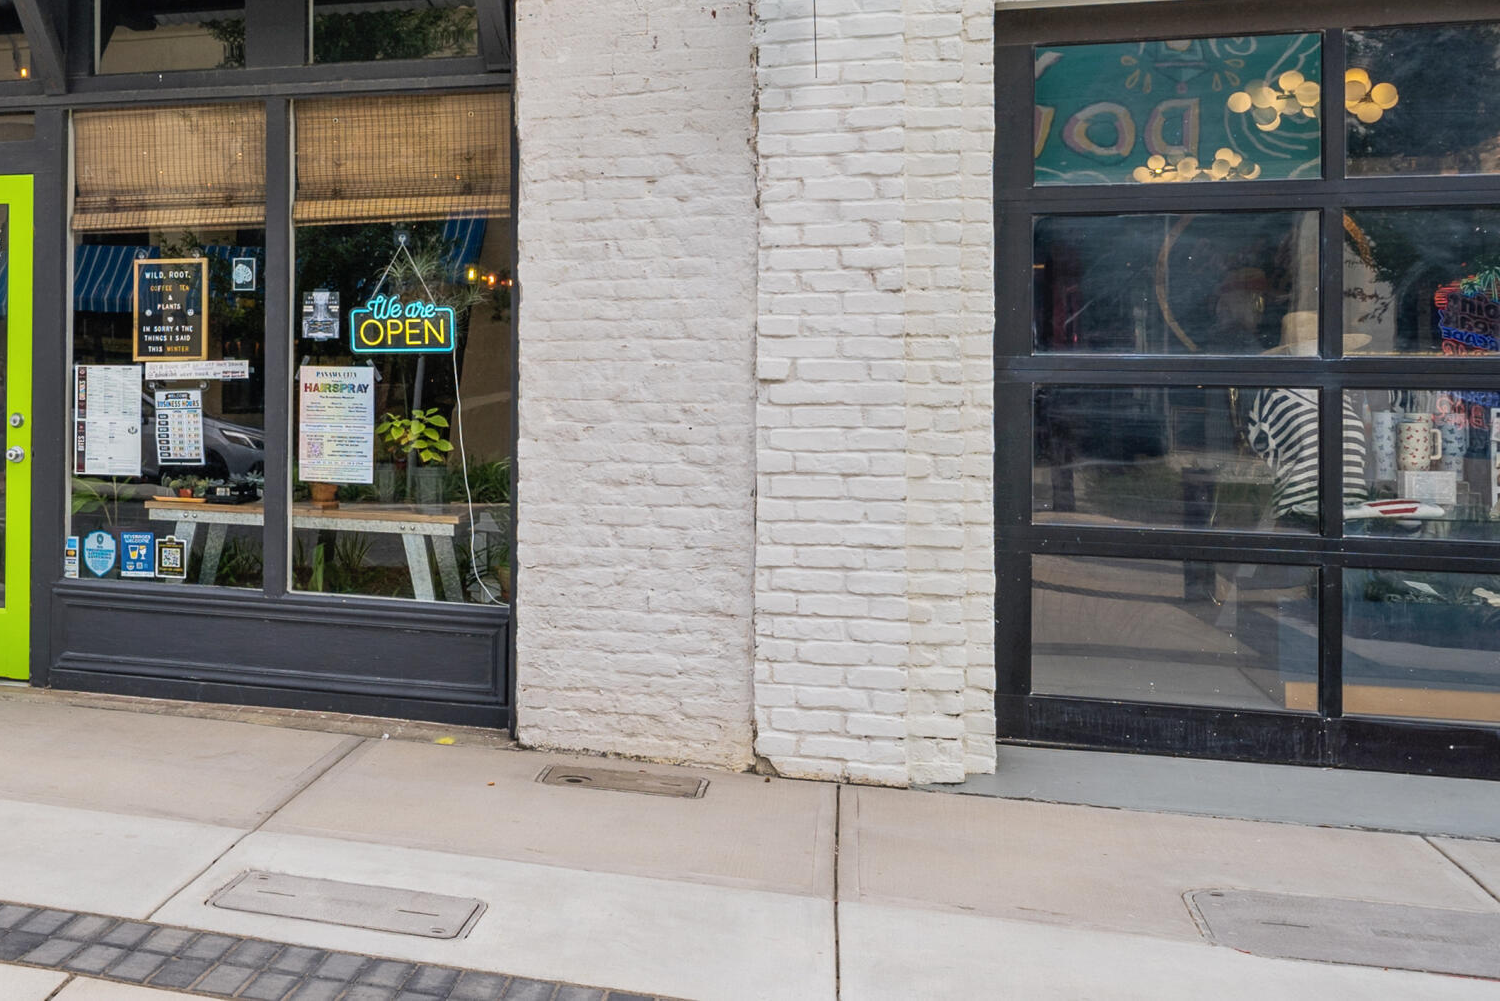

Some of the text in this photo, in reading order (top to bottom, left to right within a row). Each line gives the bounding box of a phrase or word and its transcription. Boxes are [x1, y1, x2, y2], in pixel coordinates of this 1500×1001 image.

[367, 295, 436, 319] We are
[360, 318, 445, 346] OPEN
[304, 383, 369, 393] HAIRSPRAY
